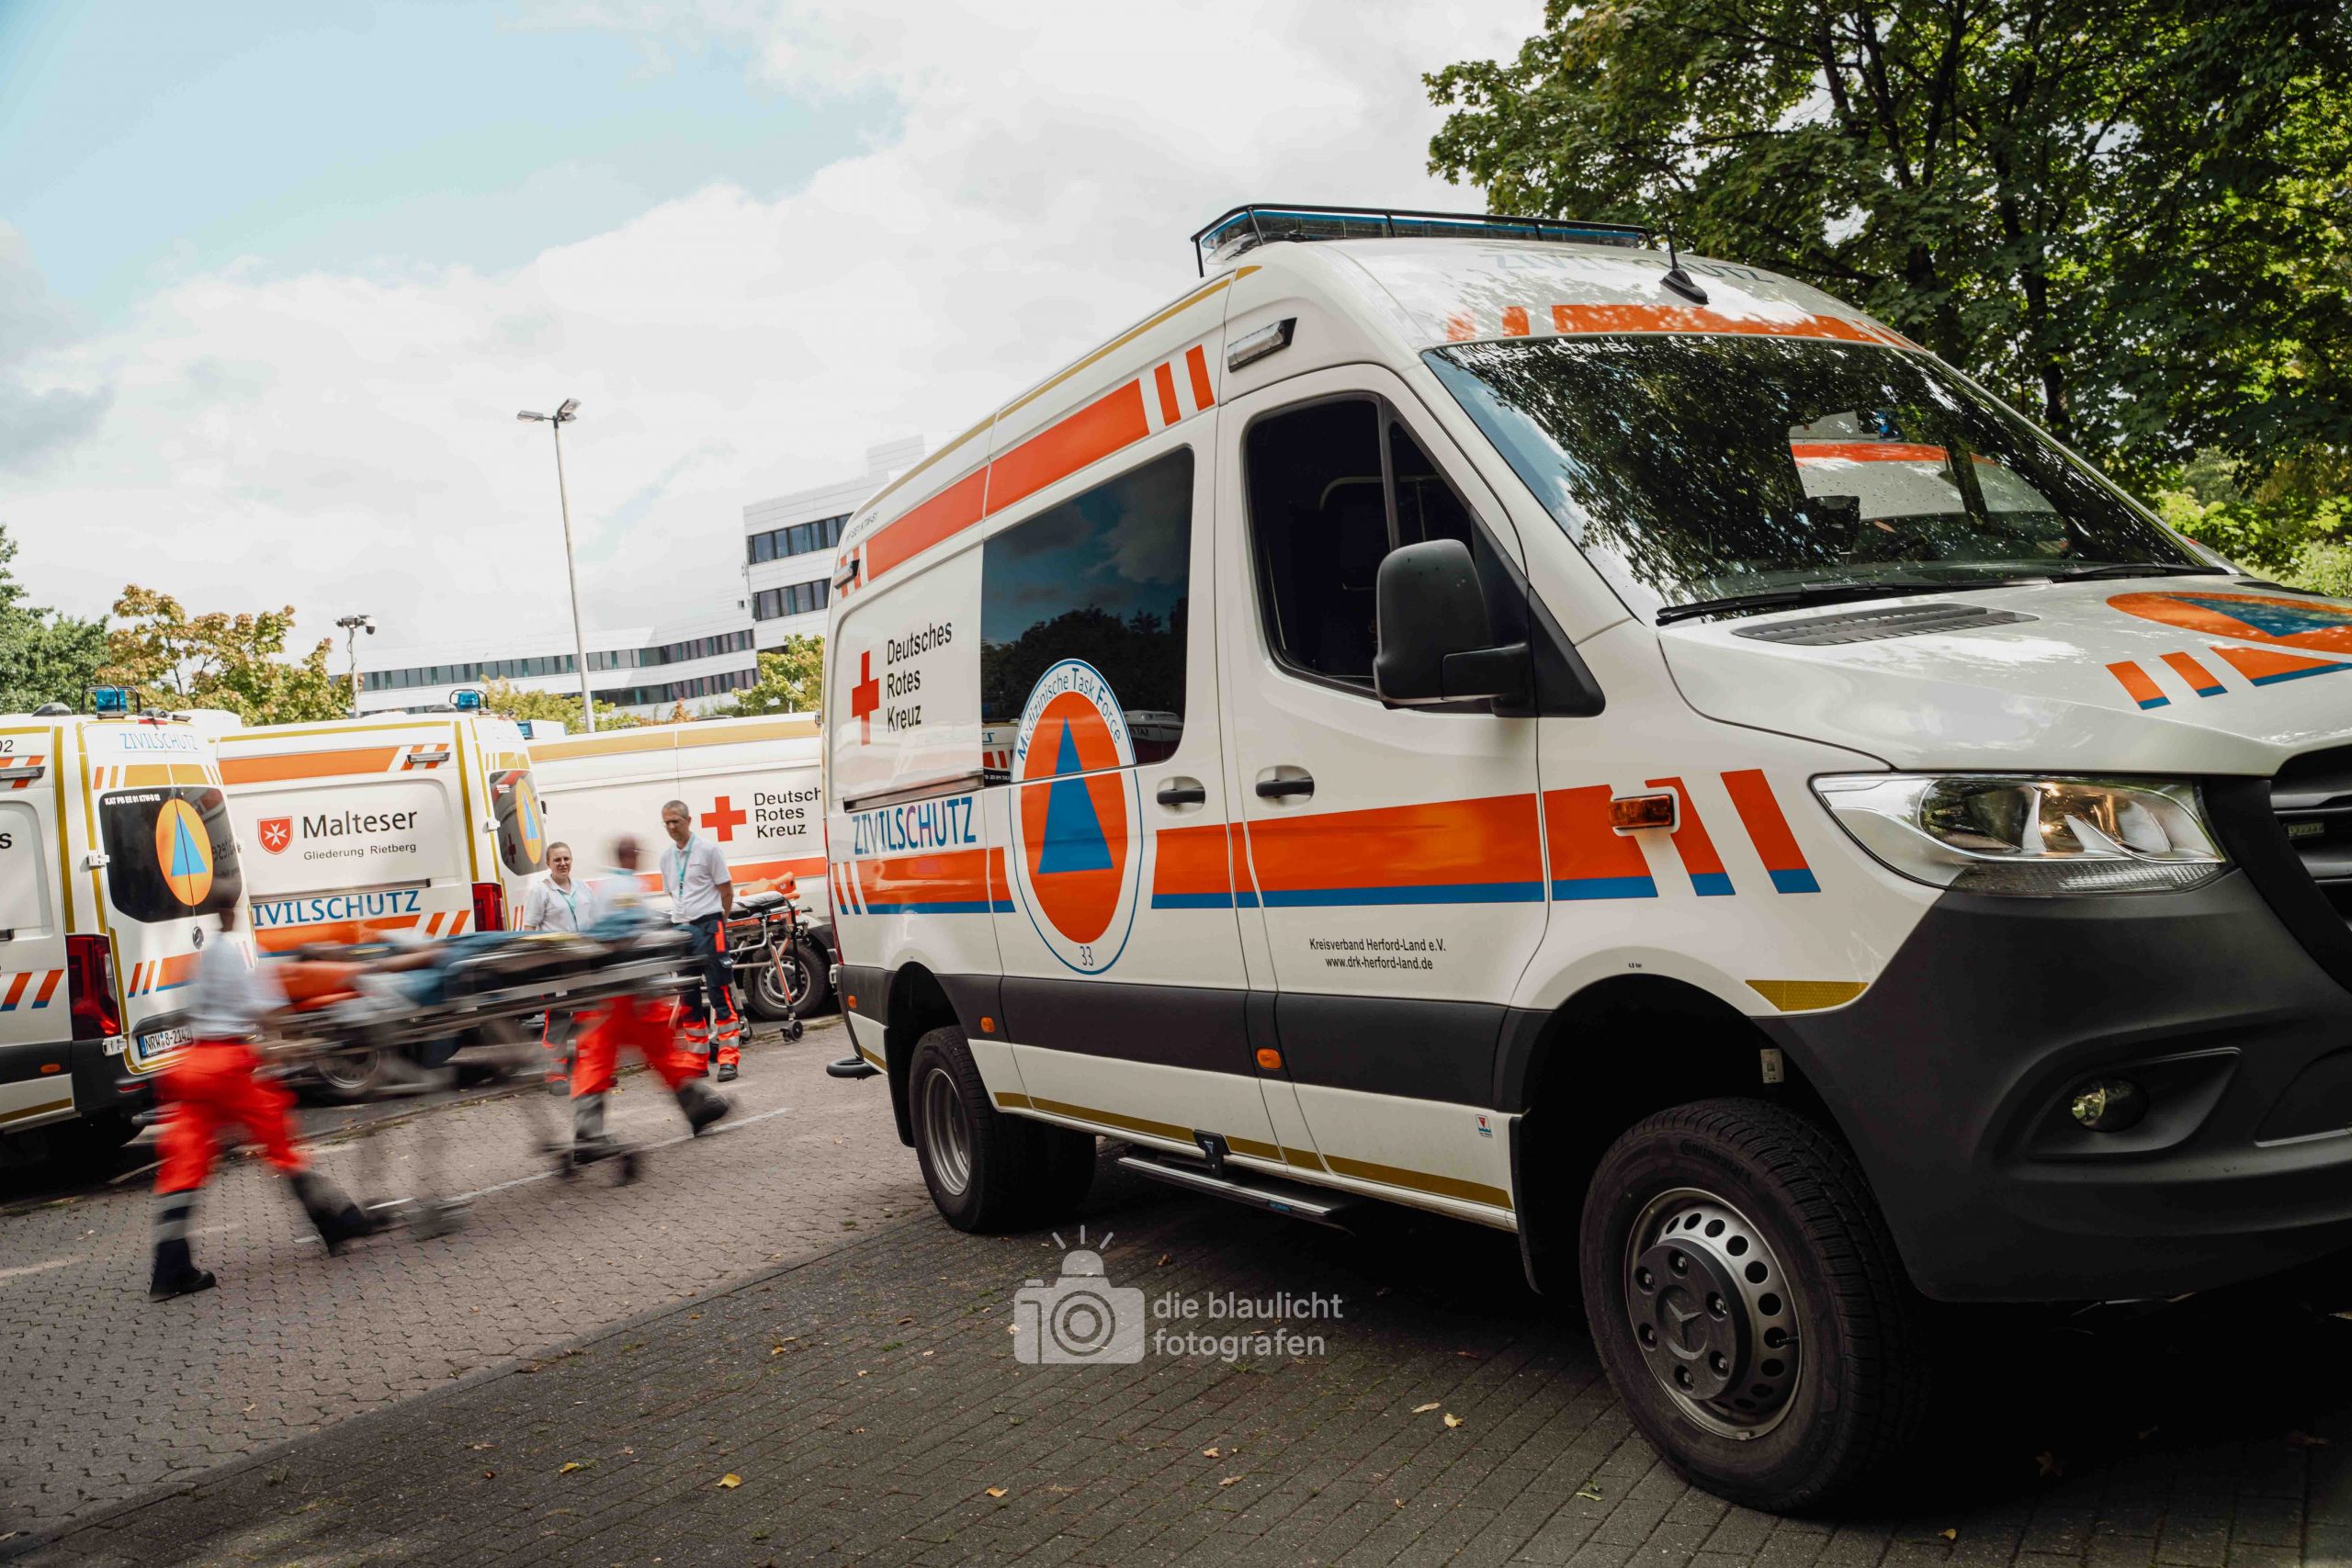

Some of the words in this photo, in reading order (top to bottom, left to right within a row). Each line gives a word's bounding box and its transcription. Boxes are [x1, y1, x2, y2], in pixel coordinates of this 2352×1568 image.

[887, 622, 952, 665] Deutsches
[887, 670, 921, 699] Rotes
[887, 705, 922, 733] Kreuz
[1017, 672, 1069, 761] Medizinische
[1072, 667, 1094, 698] Task
[1096, 685, 1121, 743] Force
[119, 733, 198, 750] ZIVILSCHUTZ
[302, 810, 418, 839] Malteser
[755, 807, 805, 823] Rotes
[757, 824, 807, 838] Kreuz
[852, 796, 977, 855] ZIVILSCHUTZ
[303, 849, 365, 861] Gliederung
[370, 844, 417, 854] Rietberg
[1309, 938, 1365, 951] Kreisverband
[1366, 938, 1427, 952] Herford-Land
[1429, 938, 1447, 952] e.V.
[1080, 945, 1094, 966] 33
[1325, 956, 1434, 970] www.drk-herford-land.de
[145, 1033, 162, 1051] NRW
